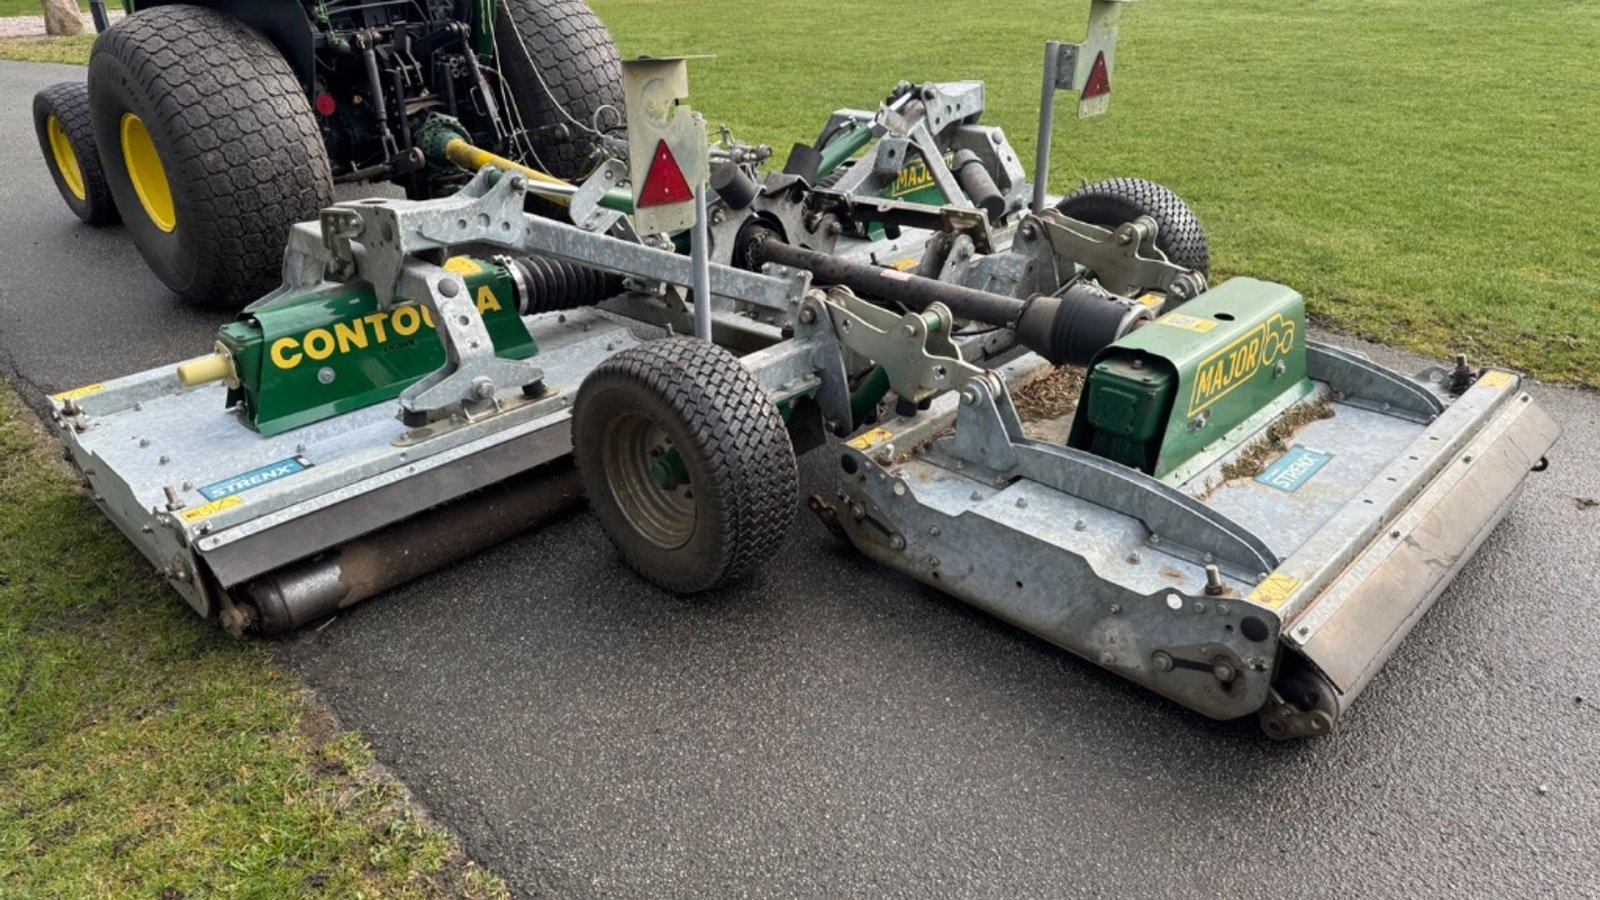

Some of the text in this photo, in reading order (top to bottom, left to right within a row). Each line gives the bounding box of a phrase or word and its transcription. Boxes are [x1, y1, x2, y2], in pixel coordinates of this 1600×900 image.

[896, 163, 933, 190] MAJ
[270, 285, 502, 370] CONTOA
[1195, 337, 1259, 405] MAJOR
[211, 465, 290, 498] STRENX
[1271, 453, 1315, 488] STRENX
